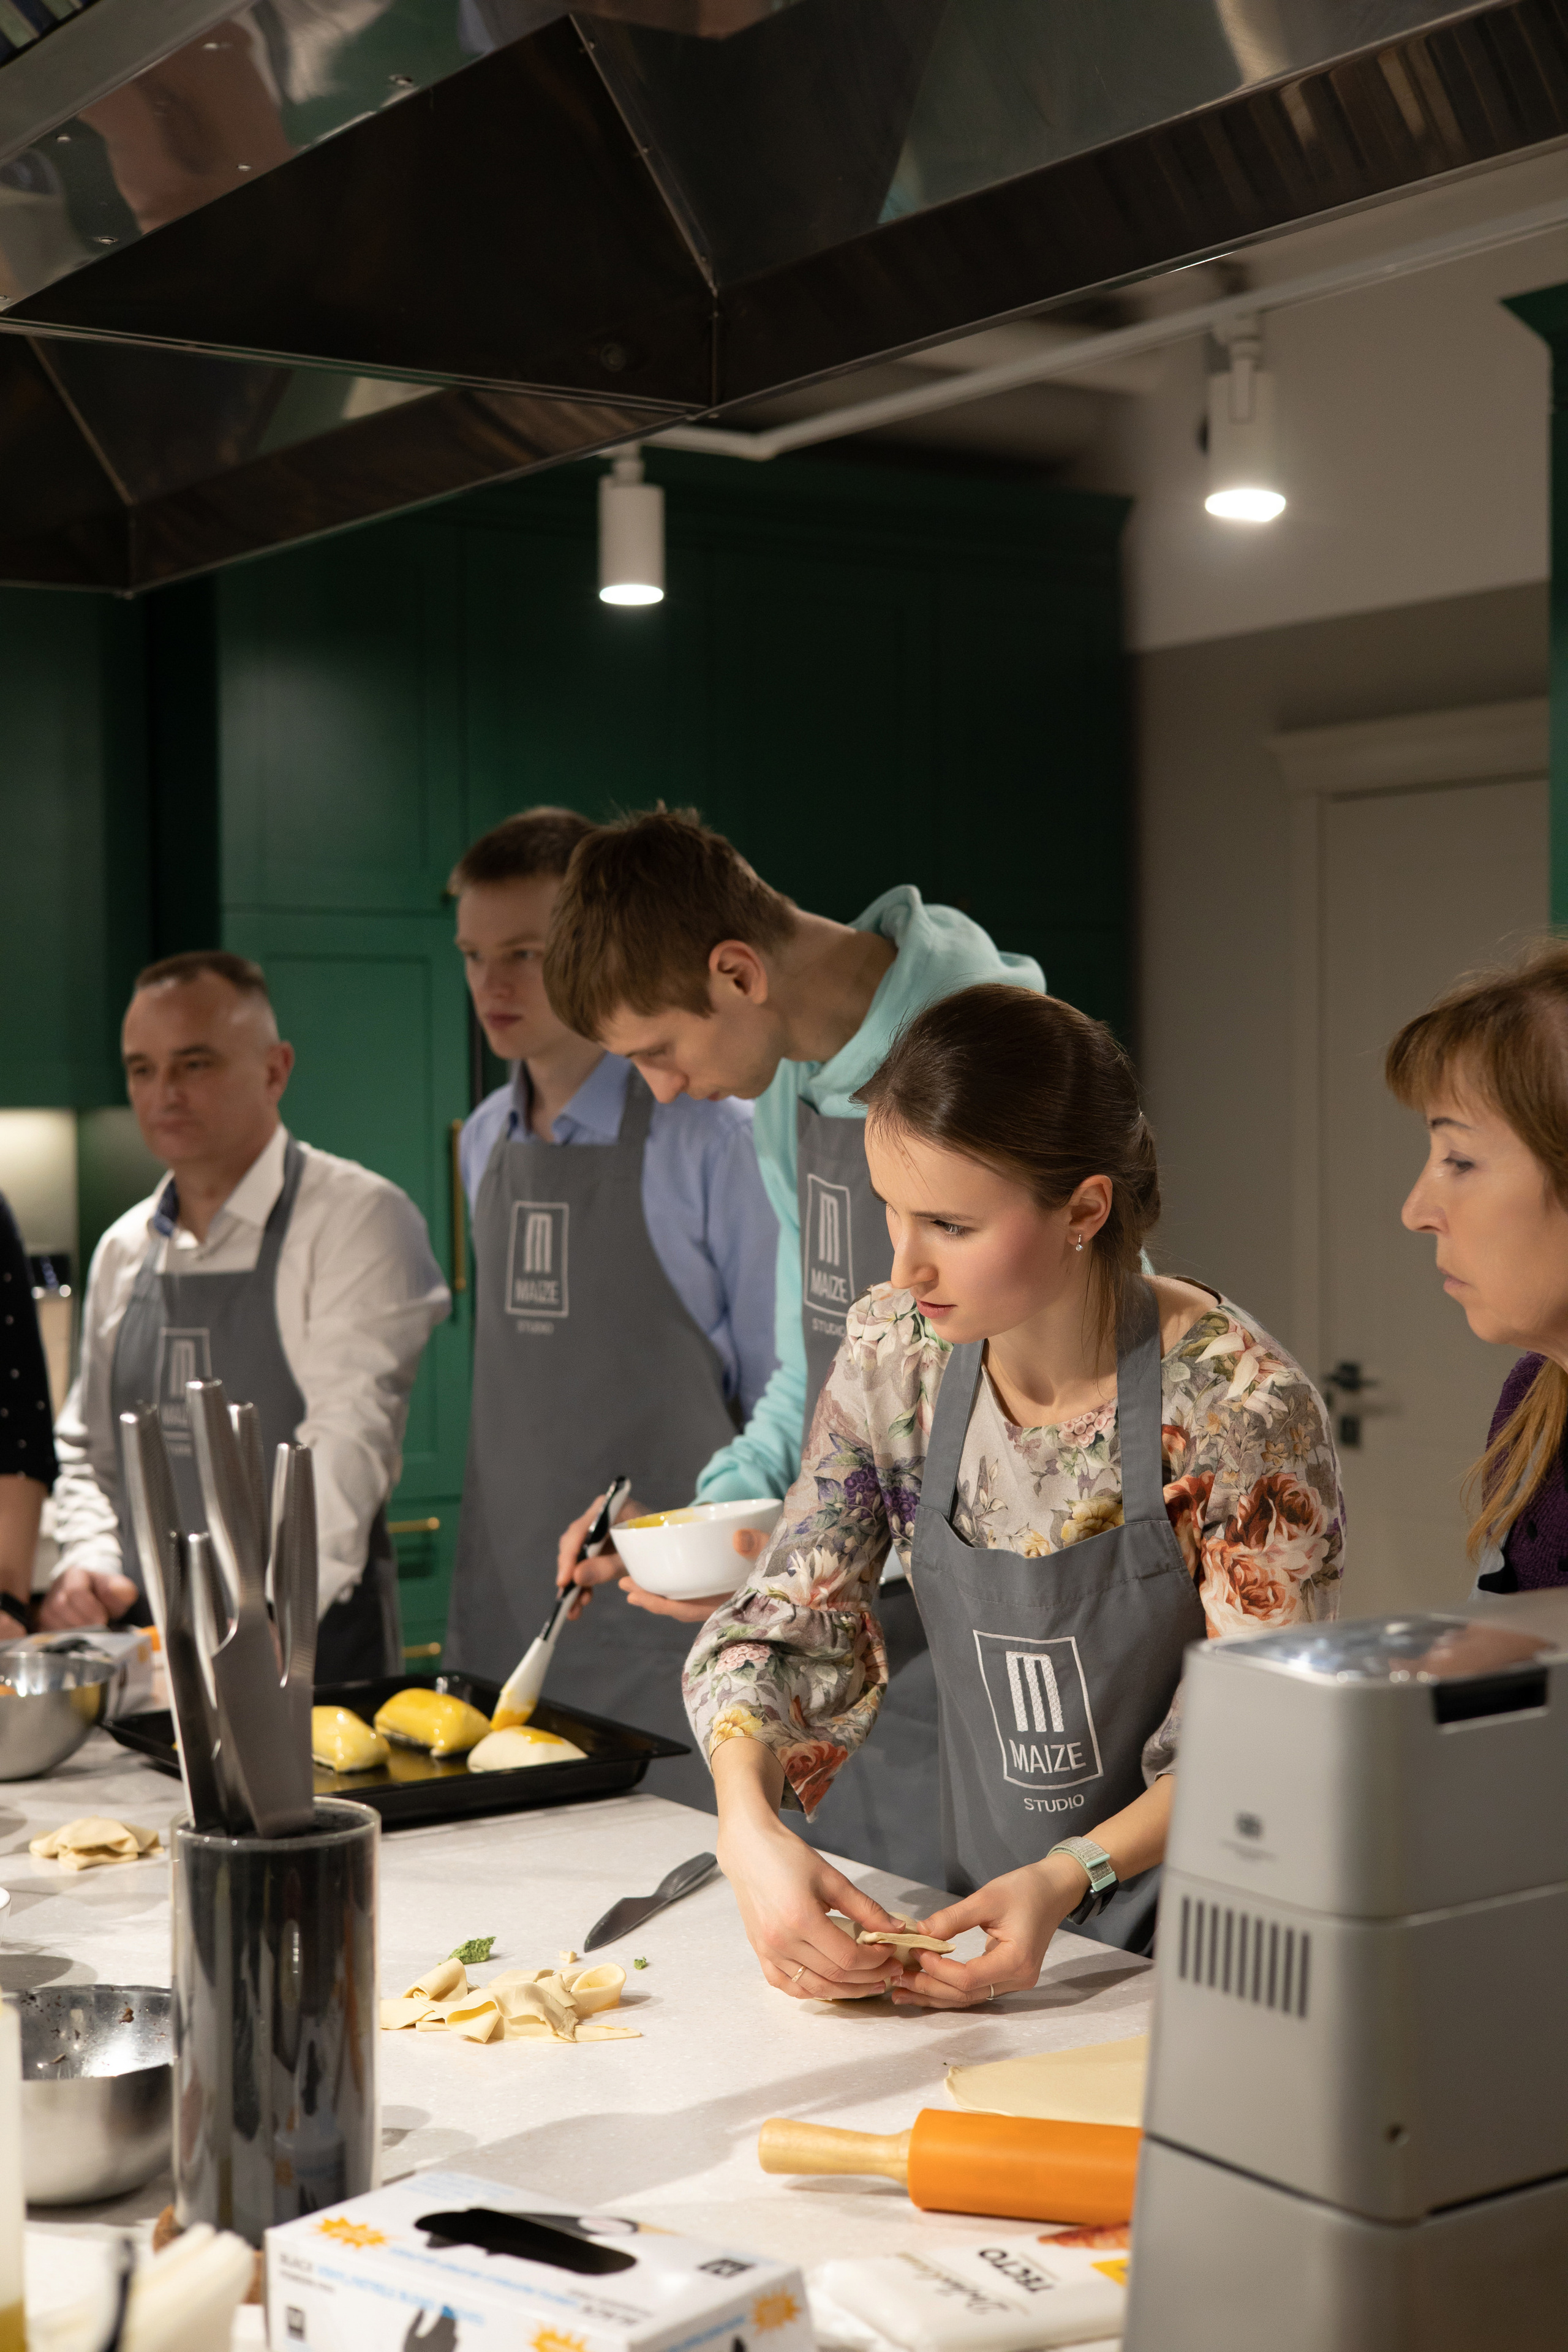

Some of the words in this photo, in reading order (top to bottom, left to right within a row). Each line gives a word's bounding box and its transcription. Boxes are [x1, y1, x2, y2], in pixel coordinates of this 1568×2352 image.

[810, 1268, 848, 1303] MAIZE
[1009, 1739, 1087, 1774] MAIZE
[1023, 1793, 1085, 1813] STUDIO
